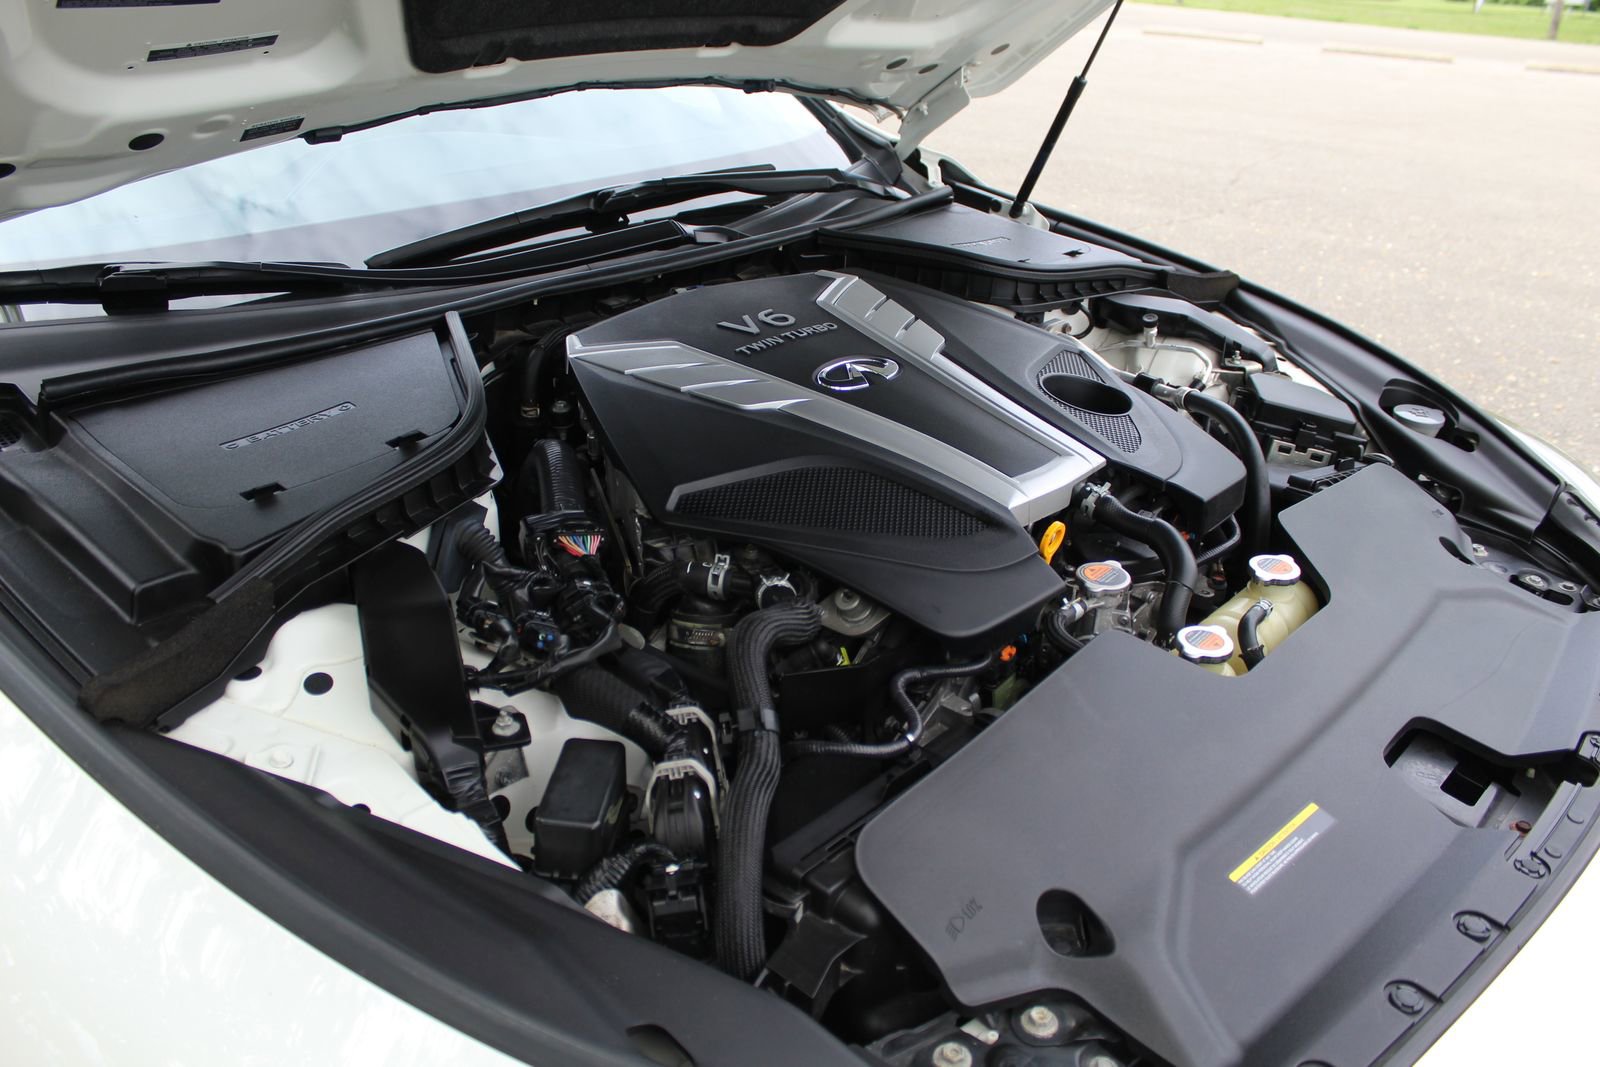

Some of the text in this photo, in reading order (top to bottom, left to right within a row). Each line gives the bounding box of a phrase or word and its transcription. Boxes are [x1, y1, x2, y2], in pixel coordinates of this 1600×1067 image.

[716, 308, 797, 335] V6
[735, 322, 838, 355] TWIN TURBO
[245, 413, 331, 444] BATTERY
